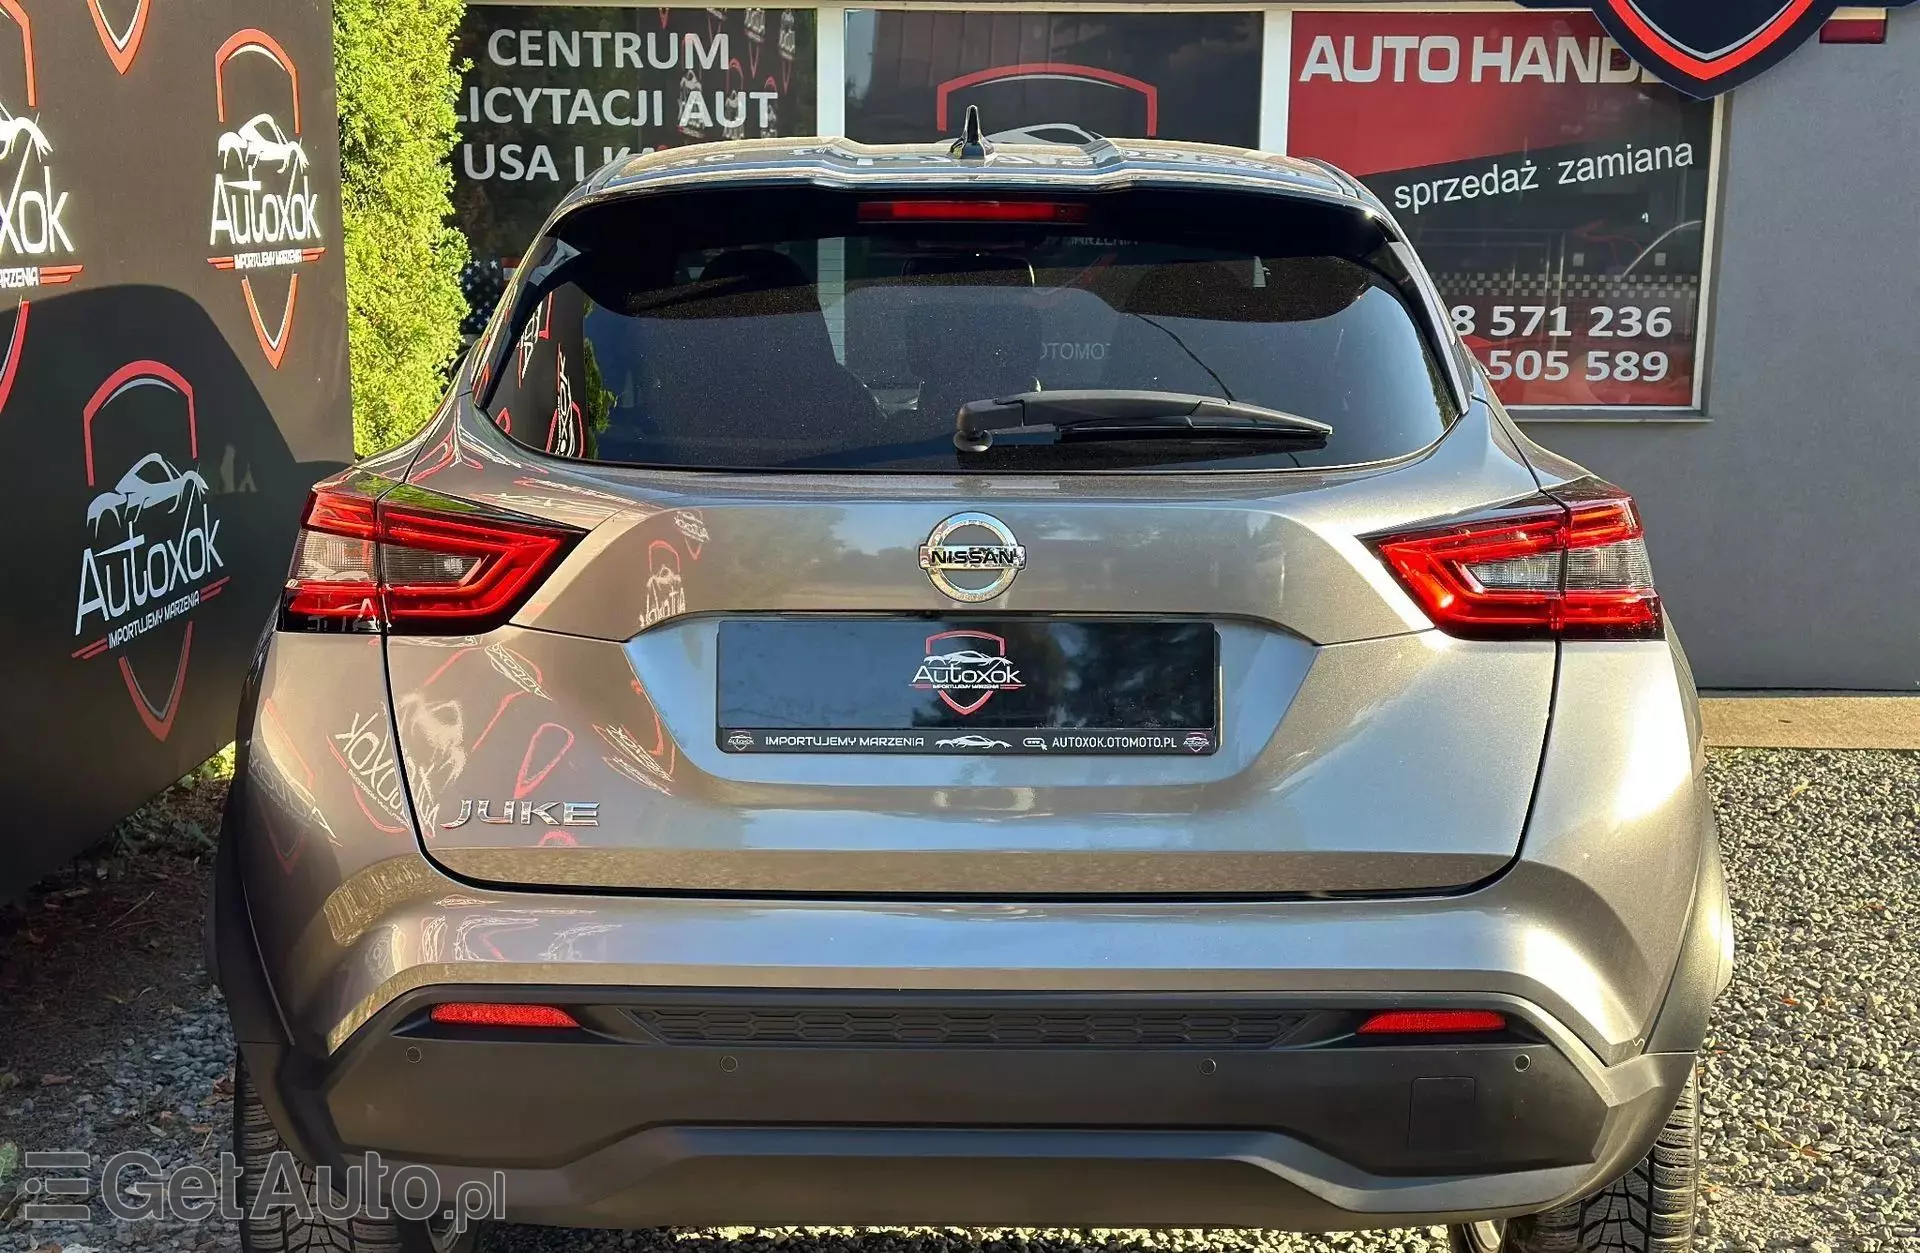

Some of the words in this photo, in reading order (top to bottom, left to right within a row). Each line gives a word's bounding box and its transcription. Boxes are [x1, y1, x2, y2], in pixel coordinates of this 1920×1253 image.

[488, 29, 730, 70] CENTRUM
[1299, 35, 1460, 83] AUTO
[1470, 35, 1664, 83] HAND
[457, 86, 664, 126] ICYTACJI
[678, 90, 778, 128] AUT
[463, 143, 560, 182] USA
[574, 146, 585, 182] I
[1394, 159, 1539, 215] sprzedaż
[1557, 143, 1694, 185] zamiana
[209, 162, 322, 246] Autoxok
[1489, 305, 1573, 337] 571
[1587, 306, 1673, 338] 236
[1488, 350, 1570, 381] 505
[1584, 350, 1670, 382] 589
[75, 500, 224, 636] Autoxok
[931, 550, 1017, 565] NISSAN
[108, 608, 164, 650] IMPORTUJEMY
[163, 590, 200, 621] MARZENIA
[911, 664, 1022, 684] Autoxok
[765, 736, 854, 747] IMPORTUJEMY
[854, 737, 924, 747] MARZENIA
[1052, 737, 1177, 748] AUTOXOK.OTOMOTO.PL
[440, 799, 600, 830] JUKE
